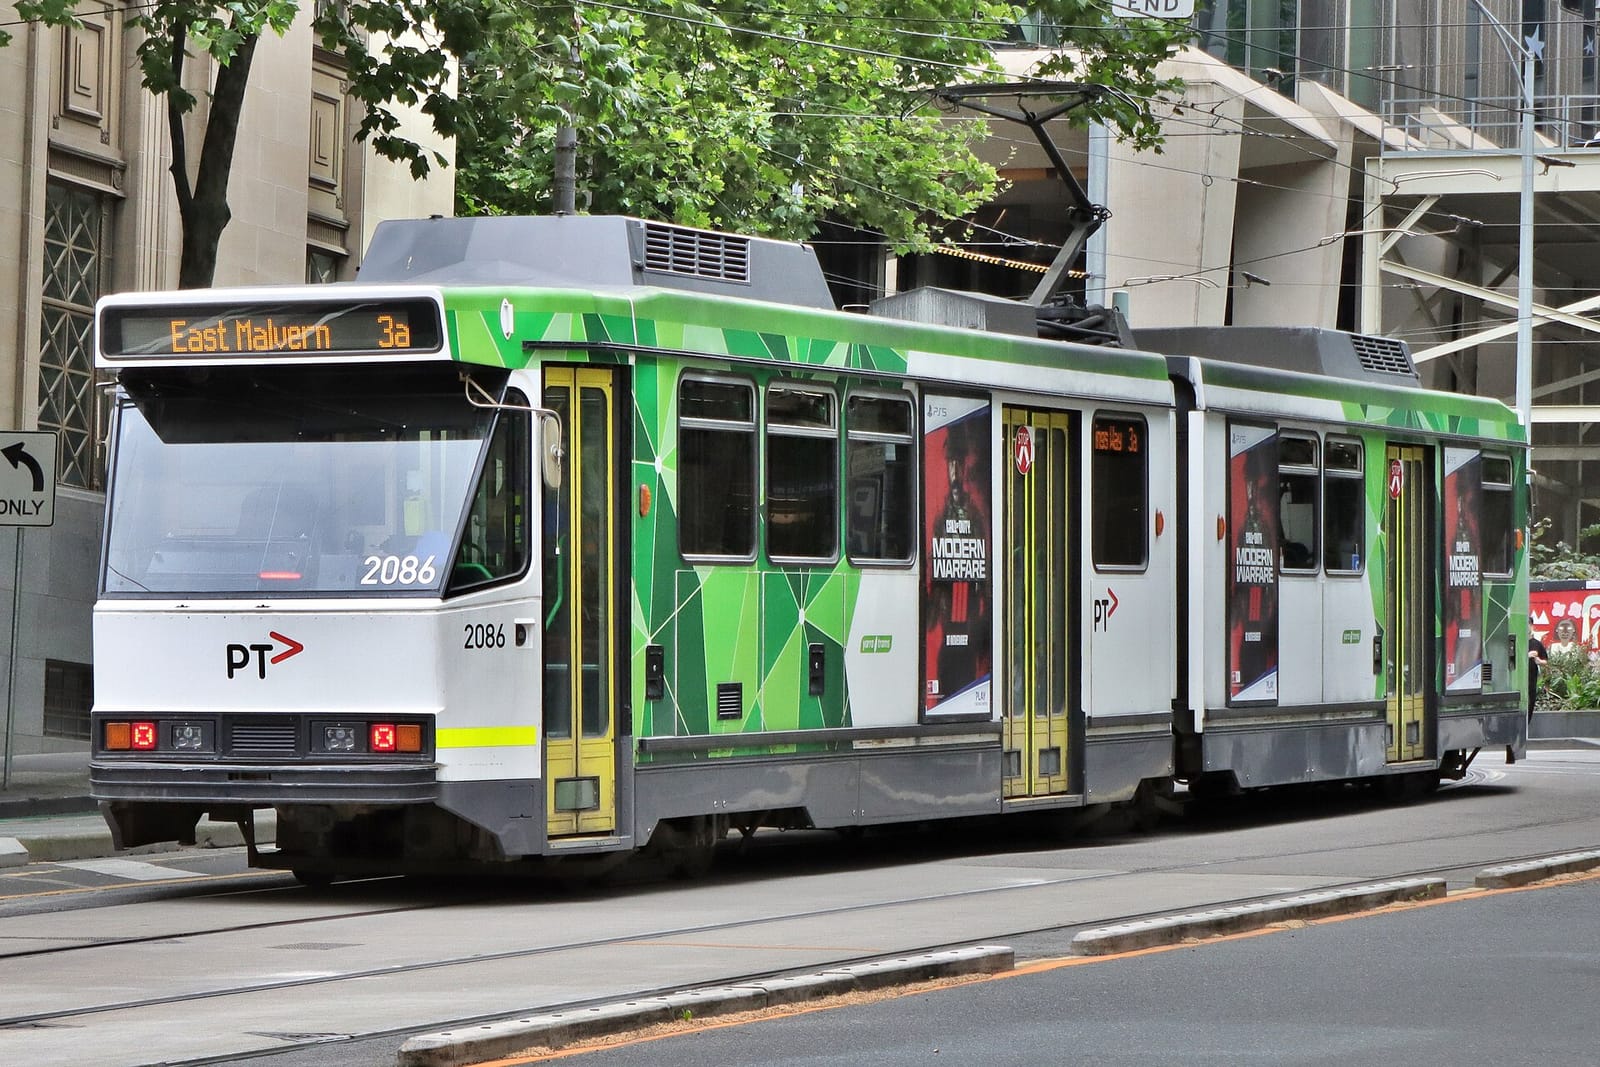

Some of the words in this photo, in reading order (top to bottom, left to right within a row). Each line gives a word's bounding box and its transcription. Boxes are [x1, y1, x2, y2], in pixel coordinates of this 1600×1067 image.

[1128, 0, 1178, 12] END
[171, 319, 229, 352] East
[236, 318, 331, 350] Malvern
[376, 315, 411, 348] 3a
[933, 407, 948, 417] PS5
[1018, 433, 1030, 445] STOP
[0, 499, 45, 516] ONLY
[932, 537, 986, 559] MODERN
[1236, 547, 1273, 566] MODERN
[360, 555, 436, 585] 2086
[933, 559, 986, 579] WARFARE
[1449, 555, 1479, 571] MODERN
[1236, 566, 1274, 584] WARFARE
[464, 623, 506, 649] 2086
